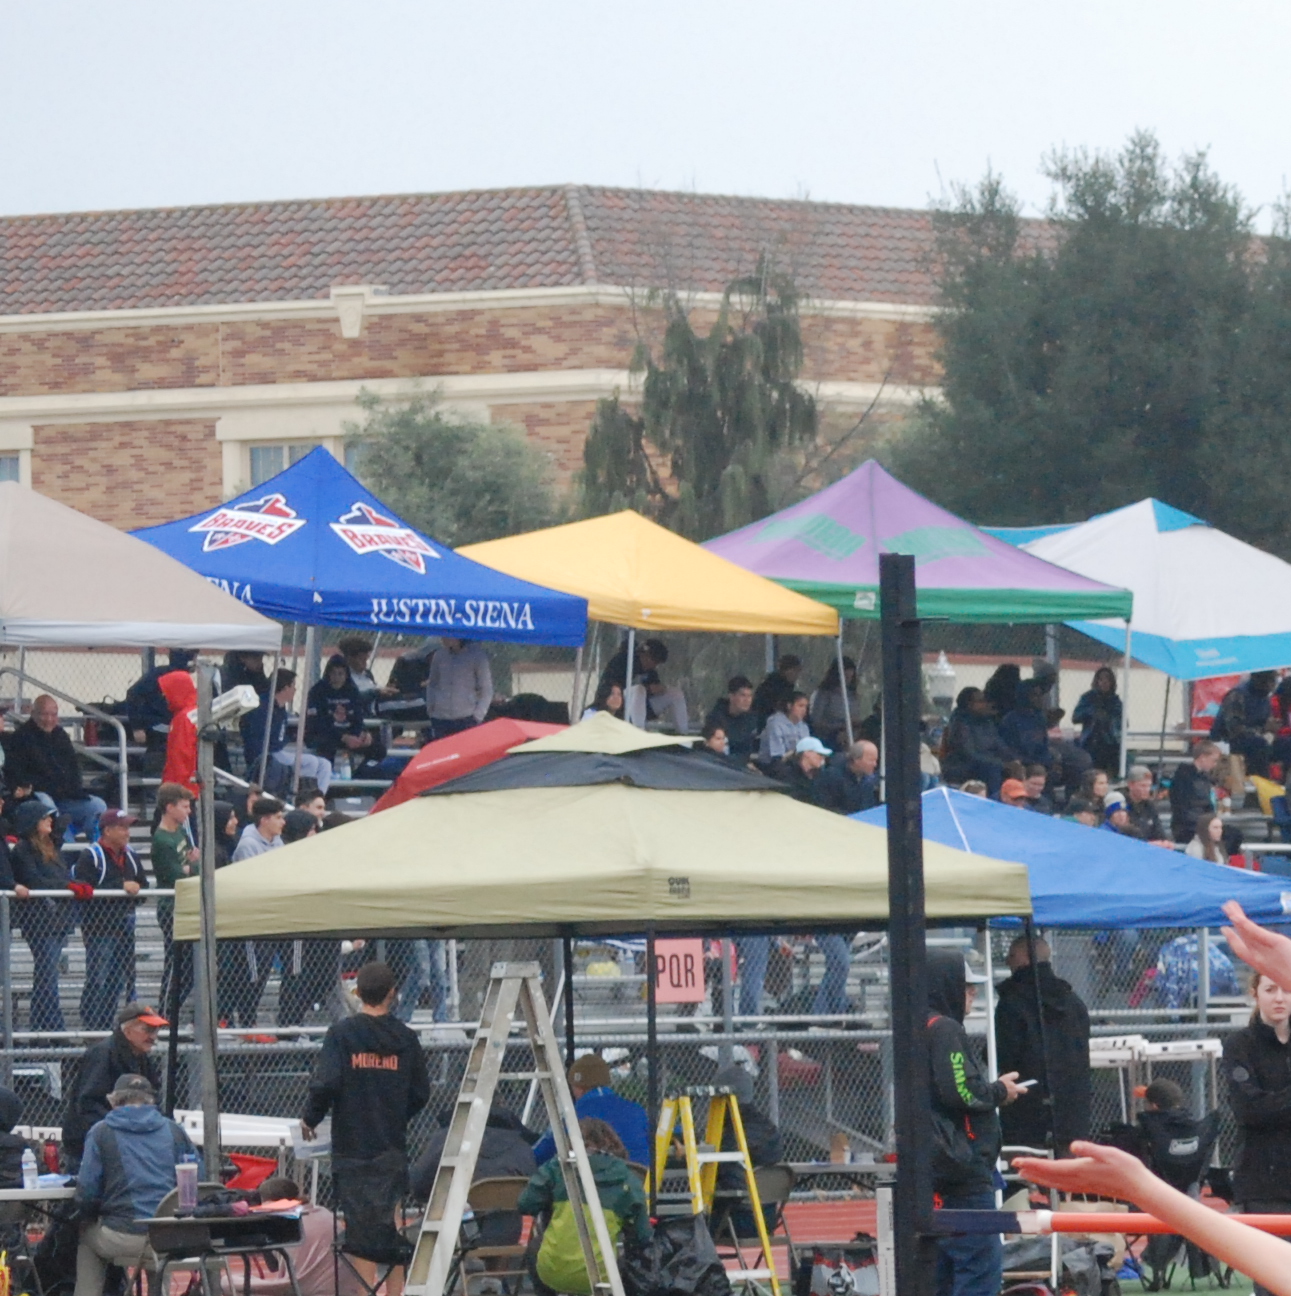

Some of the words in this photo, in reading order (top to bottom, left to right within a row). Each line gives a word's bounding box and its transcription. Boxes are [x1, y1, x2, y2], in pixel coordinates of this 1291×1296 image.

[201, 512, 295, 539] BRAVES
[338, 527, 430, 553] BRAVES
[369, 598, 535, 630] JUSTIN-SIENA
[656, 953, 696, 989] PQR
